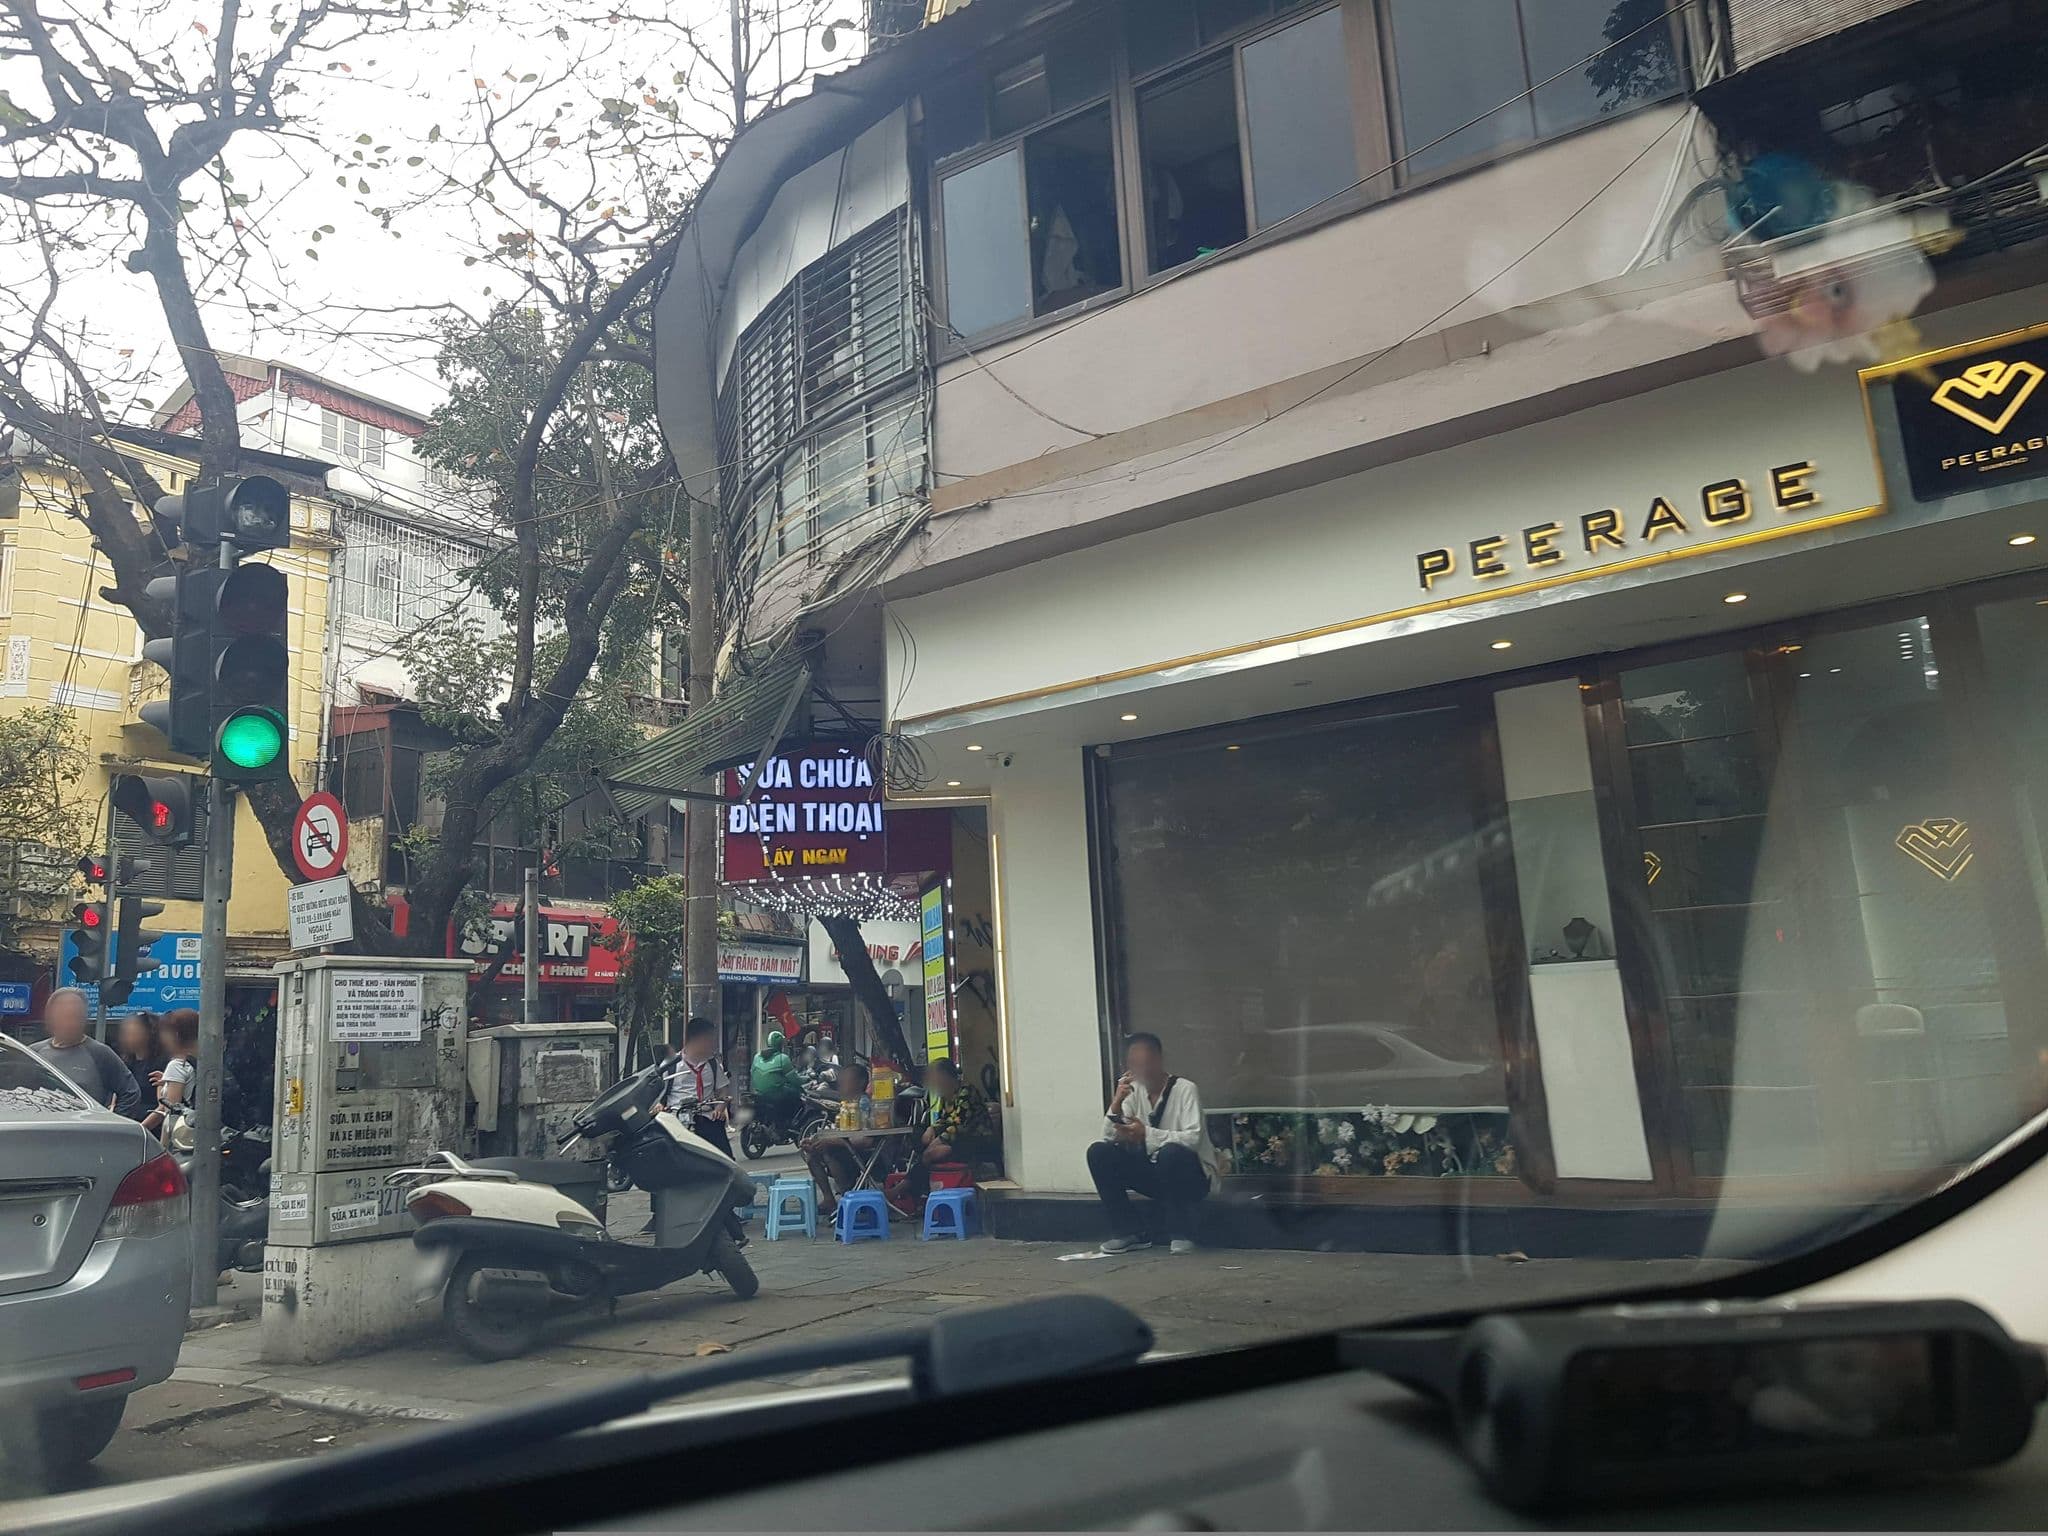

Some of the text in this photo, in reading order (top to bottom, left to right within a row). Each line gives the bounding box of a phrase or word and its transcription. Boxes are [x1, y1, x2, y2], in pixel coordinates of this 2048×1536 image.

[1416, 460, 1820, 592] PEERAGE
[799, 748, 873, 788] CHỮA
[729, 794, 882, 841] ĐIỆN THOẠI
[802, 848, 848, 865] NGAY
[334, 979, 347, 987] CHO
[365, 979, 379, 987] KHO
[348, 1208, 358, 1219] XE
